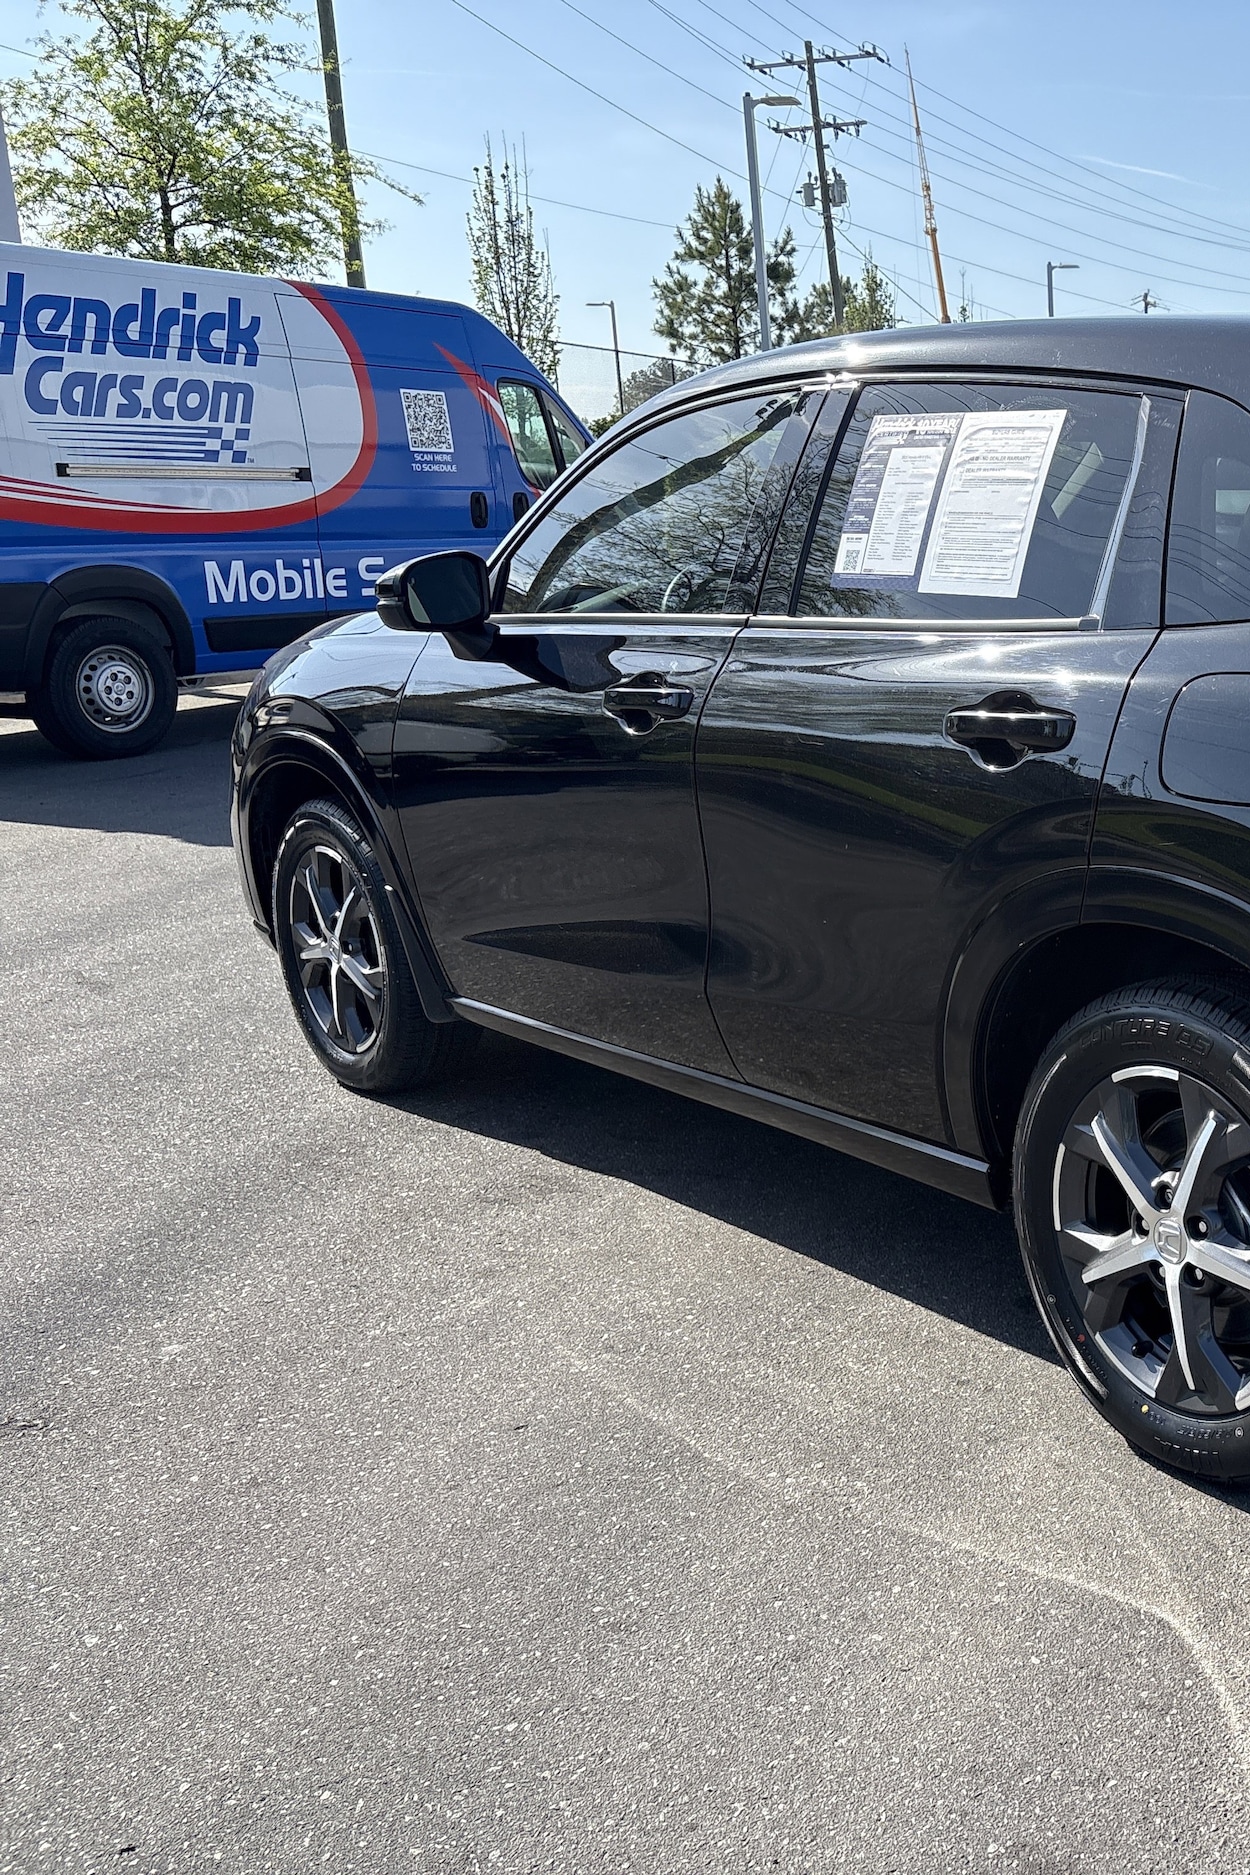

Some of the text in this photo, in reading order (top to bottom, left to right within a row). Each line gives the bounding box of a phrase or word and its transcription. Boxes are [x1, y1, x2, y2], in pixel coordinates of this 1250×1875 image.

[24, 355, 254, 424] Cars.com
[411, 463, 457, 473] TO SCHEDULE
[413, 453, 453, 462] SCAN HERE
[204, 558, 348, 604] Mobile
